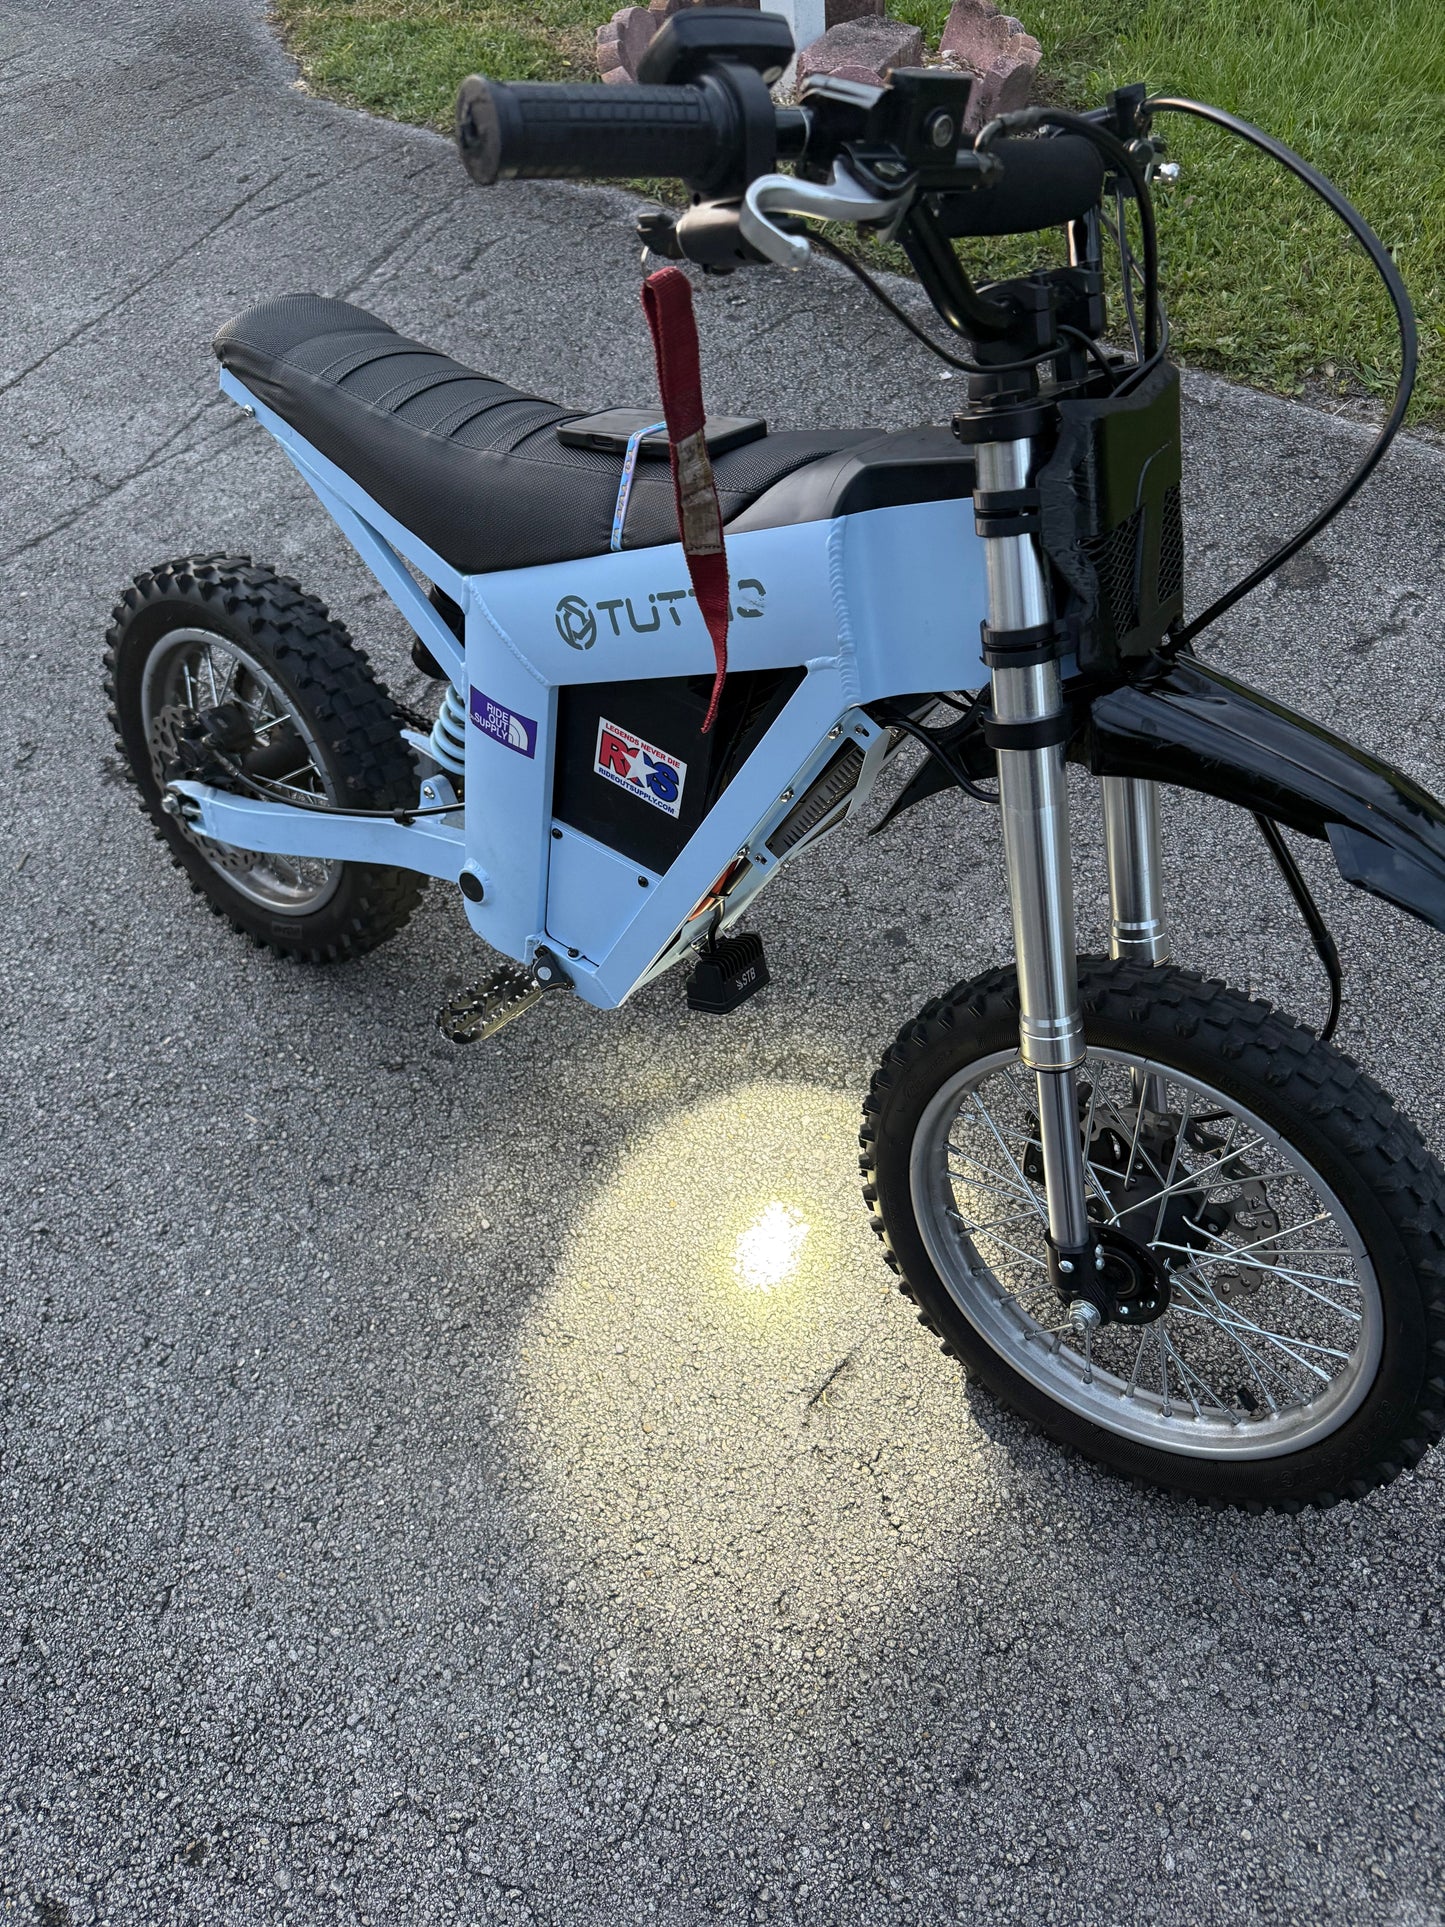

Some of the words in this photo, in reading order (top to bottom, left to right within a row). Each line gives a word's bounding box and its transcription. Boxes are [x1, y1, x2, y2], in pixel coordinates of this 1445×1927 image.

[474, 712, 509, 740] SUPPLY
[486, 702, 509, 722] RIDE
[488, 713, 509, 732] OUT
[605, 722, 640, 747] LEGENDS
[641, 742, 666, 761] NEVER
[667, 756, 681, 769] DIE
[598, 766, 675, 815] RIDEOUTSUPPLY.COM
